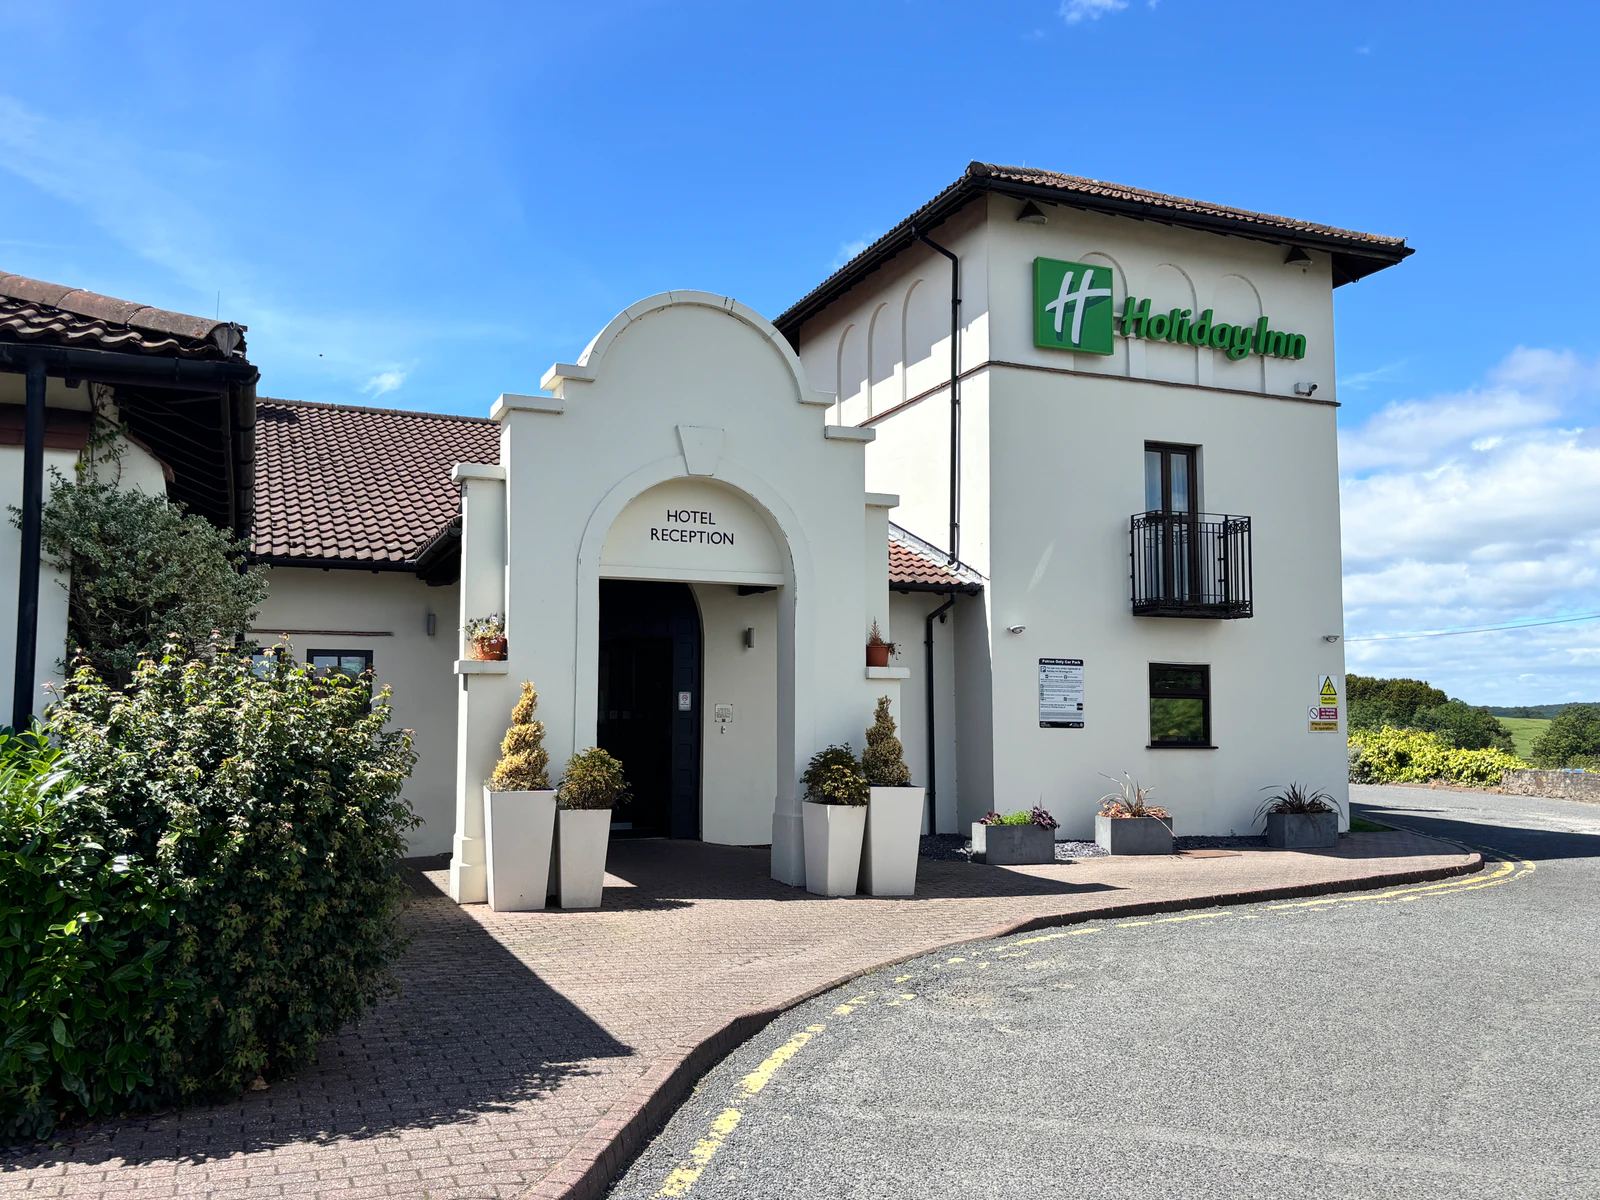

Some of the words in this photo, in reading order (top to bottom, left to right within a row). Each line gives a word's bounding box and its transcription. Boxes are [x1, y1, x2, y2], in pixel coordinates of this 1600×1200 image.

[1045, 269, 1112, 344] H
[1120, 296, 1253, 361] Holiday
[1254, 316, 1306, 360] Inn
[650, 527, 734, 545] RECEPTION
[667, 509, 716, 525] HOTEL
